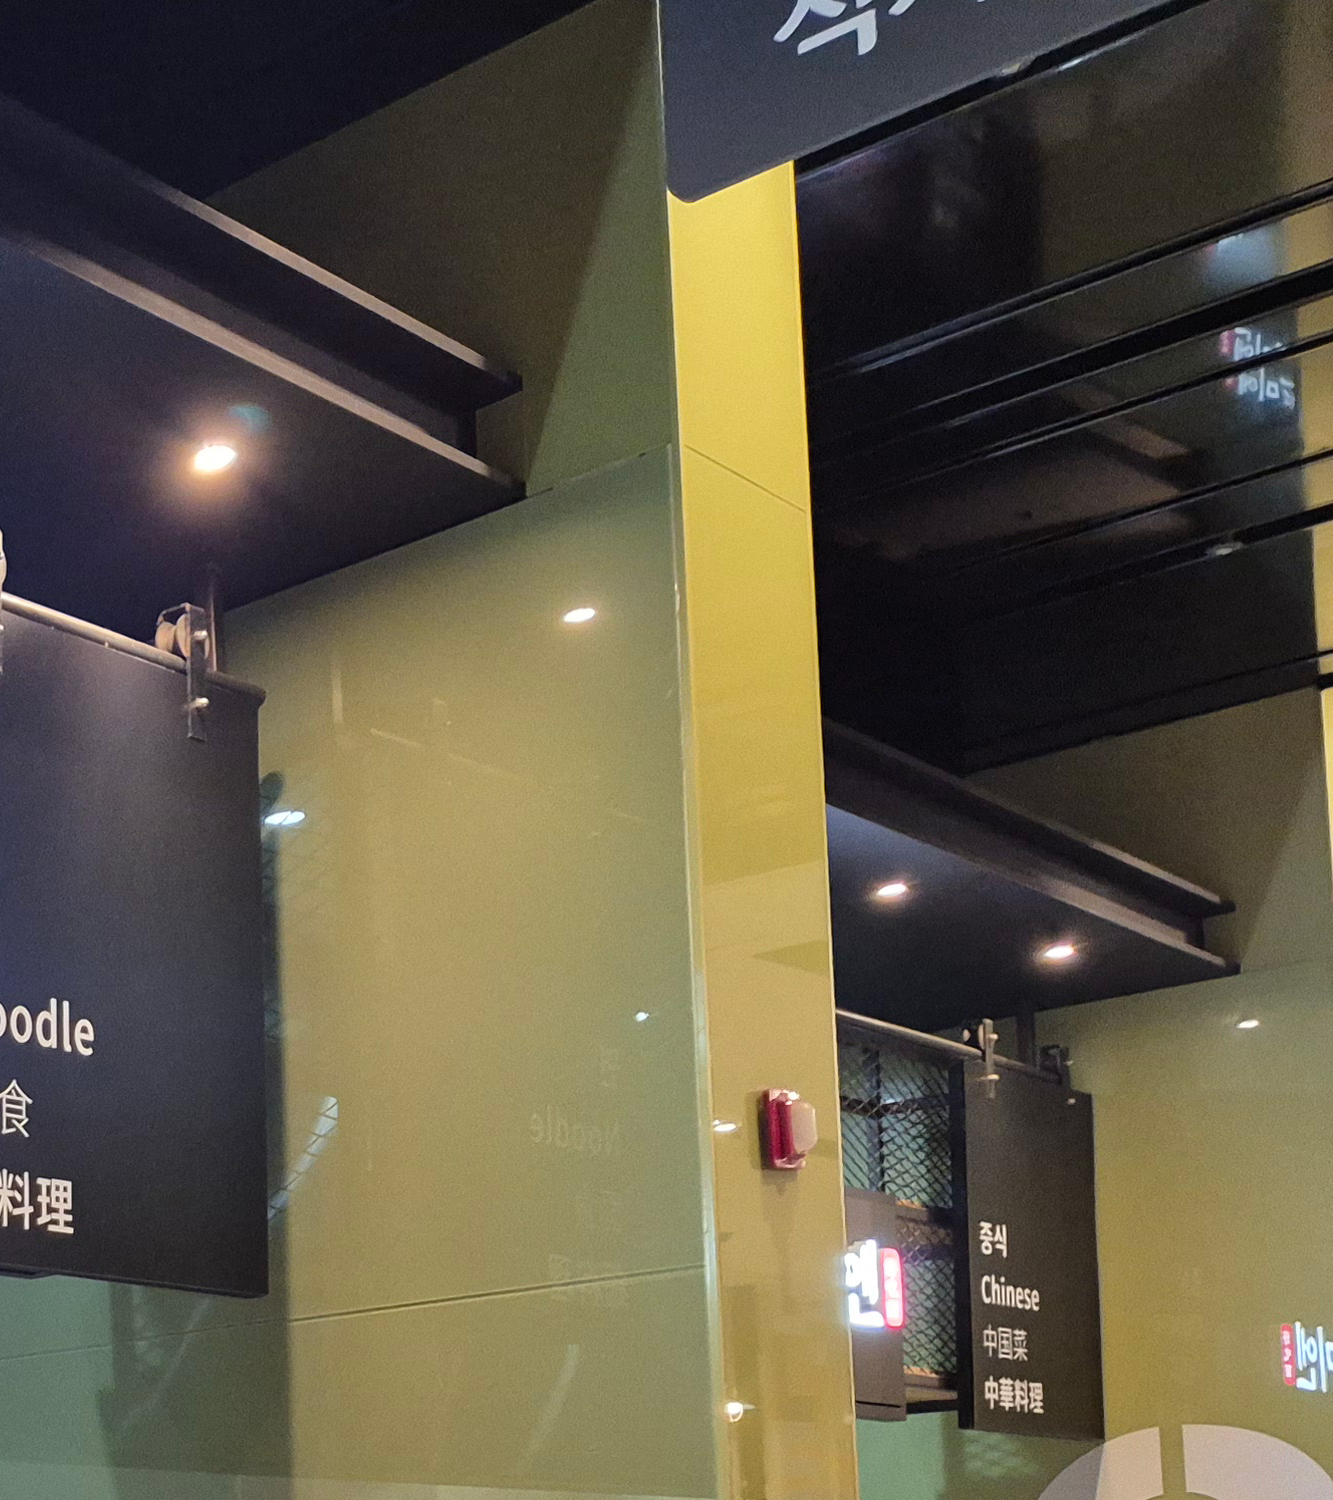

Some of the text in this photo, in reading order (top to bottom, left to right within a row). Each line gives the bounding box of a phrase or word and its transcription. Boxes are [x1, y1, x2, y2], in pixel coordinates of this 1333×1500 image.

[979, 1221, 1008, 1259] 중식
[981, 1274, 1041, 1312] Chinese
[982, 1323, 1030, 1363] 中国菜
[983, 1374, 1045, 1415] 中華料理
